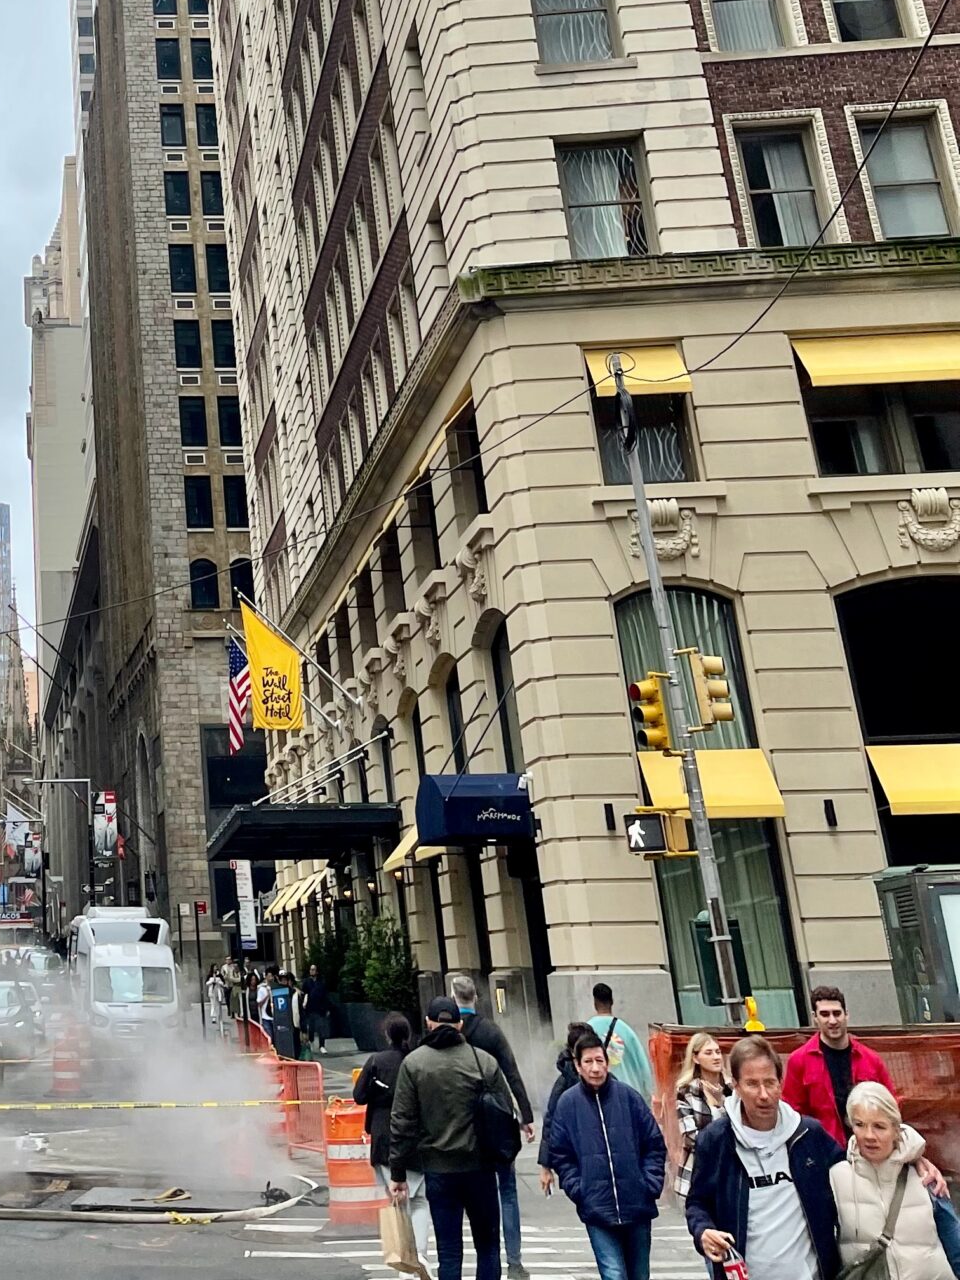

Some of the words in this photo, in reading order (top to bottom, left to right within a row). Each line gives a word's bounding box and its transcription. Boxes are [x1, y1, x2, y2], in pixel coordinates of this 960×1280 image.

[262, 666, 279, 677] The
[262, 674, 288, 691] Wall
[261, 688, 293, 705] Street
[265, 704, 292, 721] Hotel
[277, 997, 285, 1010] P
